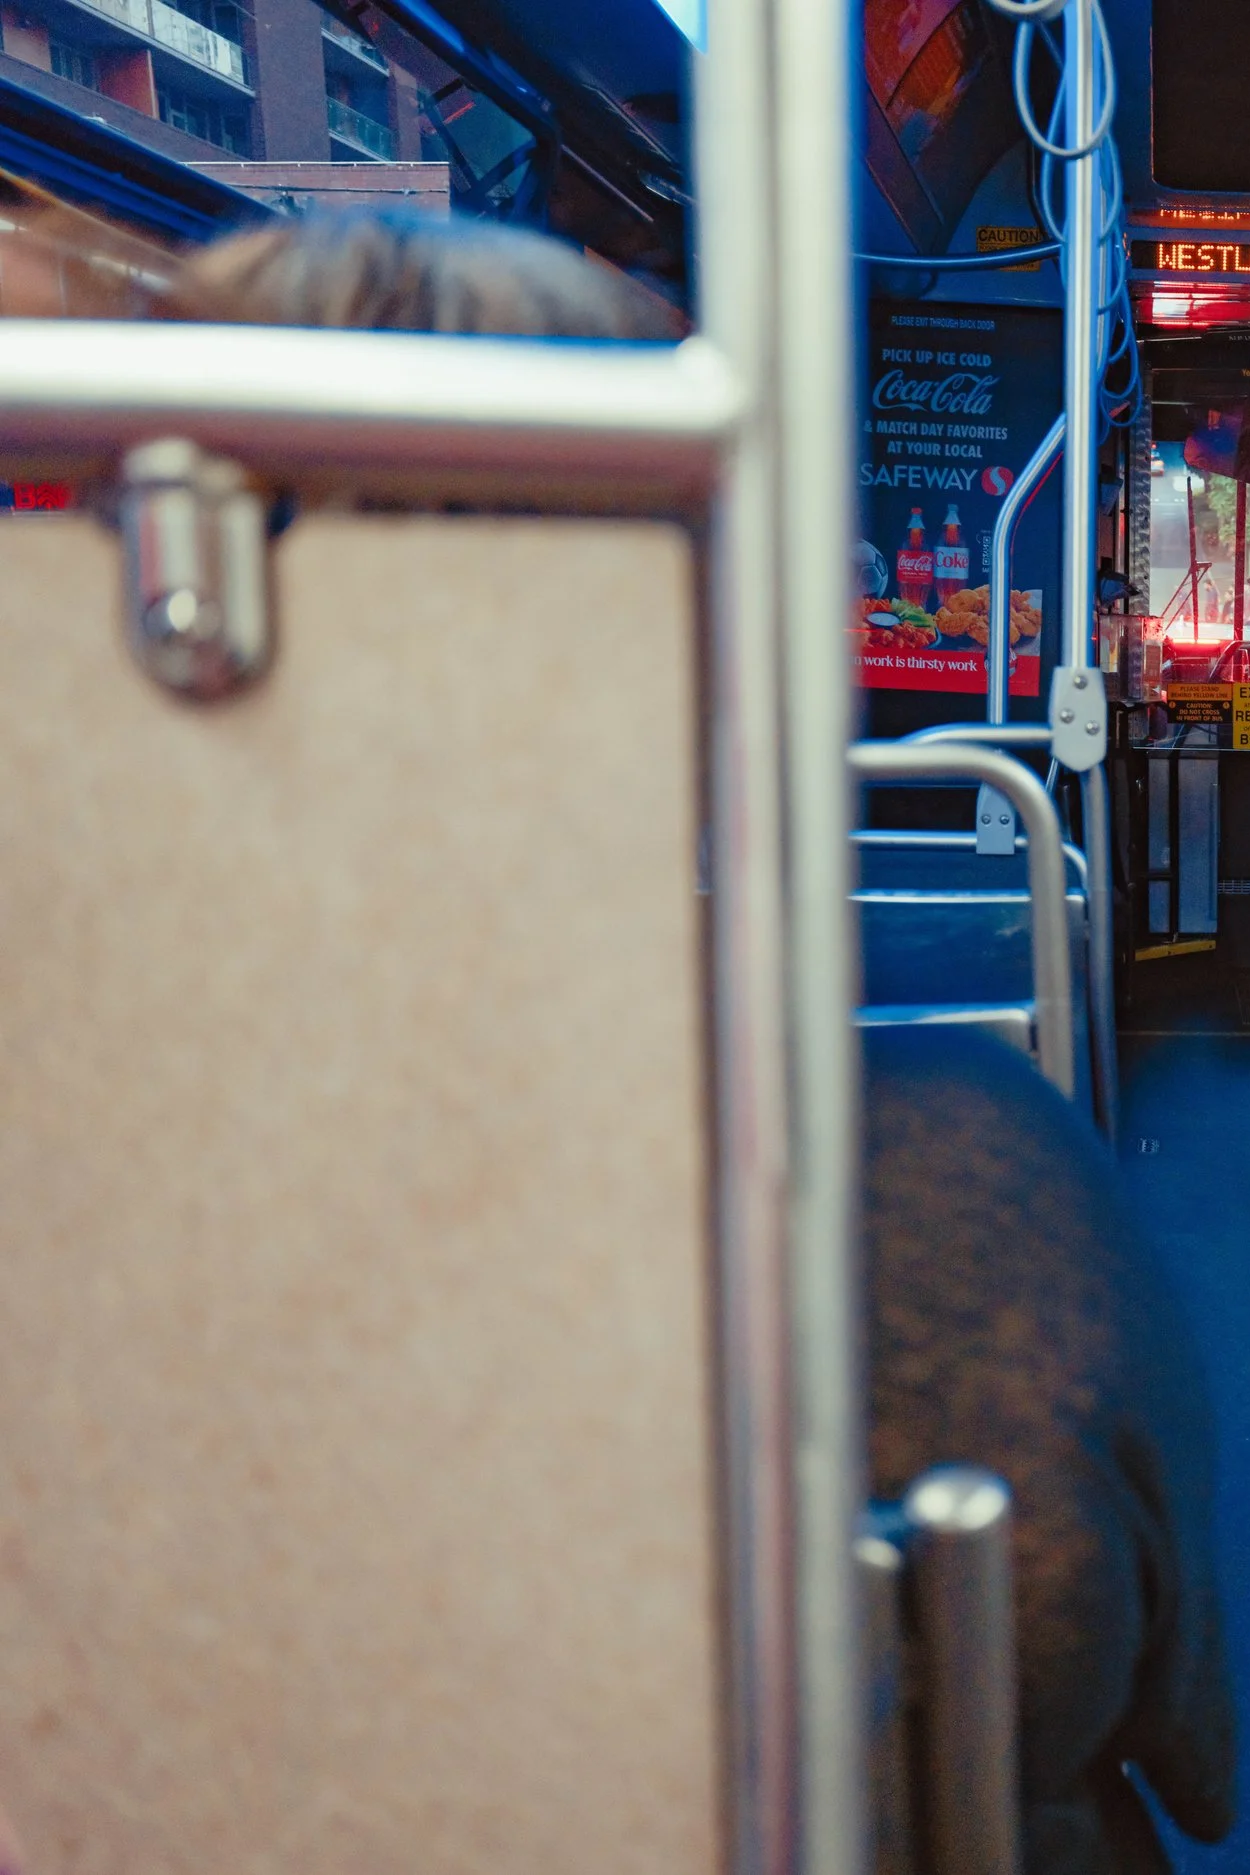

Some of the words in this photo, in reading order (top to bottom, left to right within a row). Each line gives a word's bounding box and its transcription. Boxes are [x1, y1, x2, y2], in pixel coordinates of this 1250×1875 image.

[978, 229, 1038, 242] CAUTION
[891, 315, 914, 326] PLEASE
[929, 317, 959, 329] THROUGH
[959, 319, 977, 329] BACK
[882, 348, 913, 363] PICK
[915, 350, 934, 364] UP
[936, 352, 956, 366] ICE
[959, 353, 992, 368] COLD
[872, 369, 1002, 415] Coca-Cola
[876, 420, 917, 436] MATCH
[921, 423, 944, 437] DAY
[947, 424, 1008, 440] FAVORITES
[887, 440, 902, 454] AT
[906, 442, 941, 456] YOUR
[944, 444, 983, 458] LOCAL
[859, 462, 979, 492] SAFEWAY
[898, 554, 933, 571] Coca-Cola
[935, 551, 969, 569] Coke
[864, 655, 893, 667] work
[896, 656, 905, 667] is
[907, 656, 945, 672] thirsty
[948, 660, 978, 672] work
